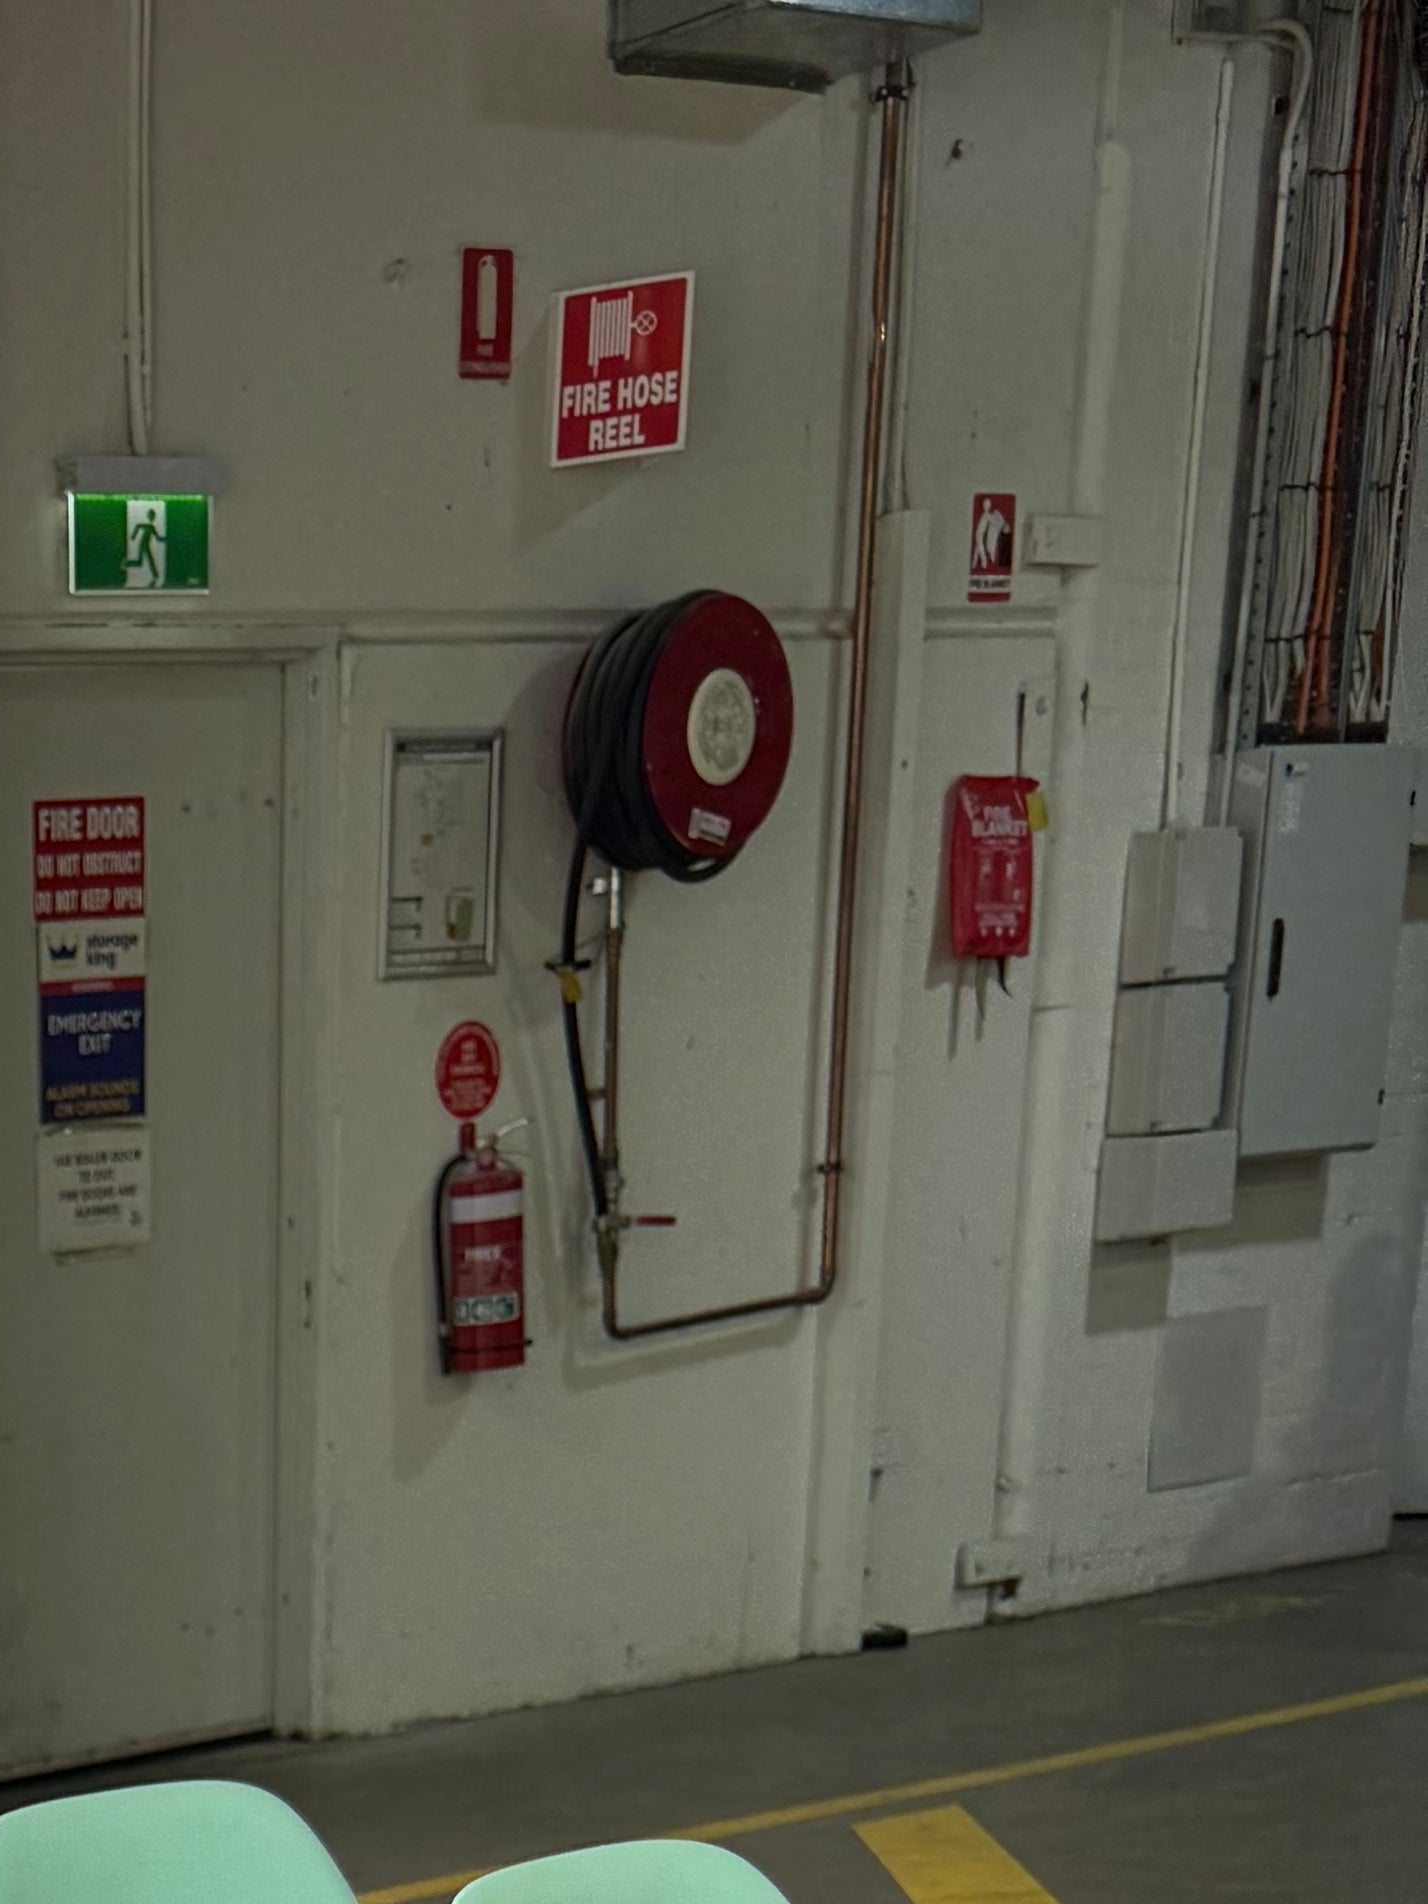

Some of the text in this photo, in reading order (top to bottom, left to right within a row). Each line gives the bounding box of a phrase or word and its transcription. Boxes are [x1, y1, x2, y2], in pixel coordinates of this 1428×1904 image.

[562, 370, 679, 418] FIRE HOSE
[589, 413, 645, 452] REEL
[38, 805, 140, 842] FIRE DOOR
[37, 854, 55, 879] DO
[56, 853, 81, 878] NOT
[35, 885, 143, 915] DO NOT KEEP OPEN
[47, 1011, 141, 1035] EMERGENCY
[78, 1032, 112, 1057] EXIT
